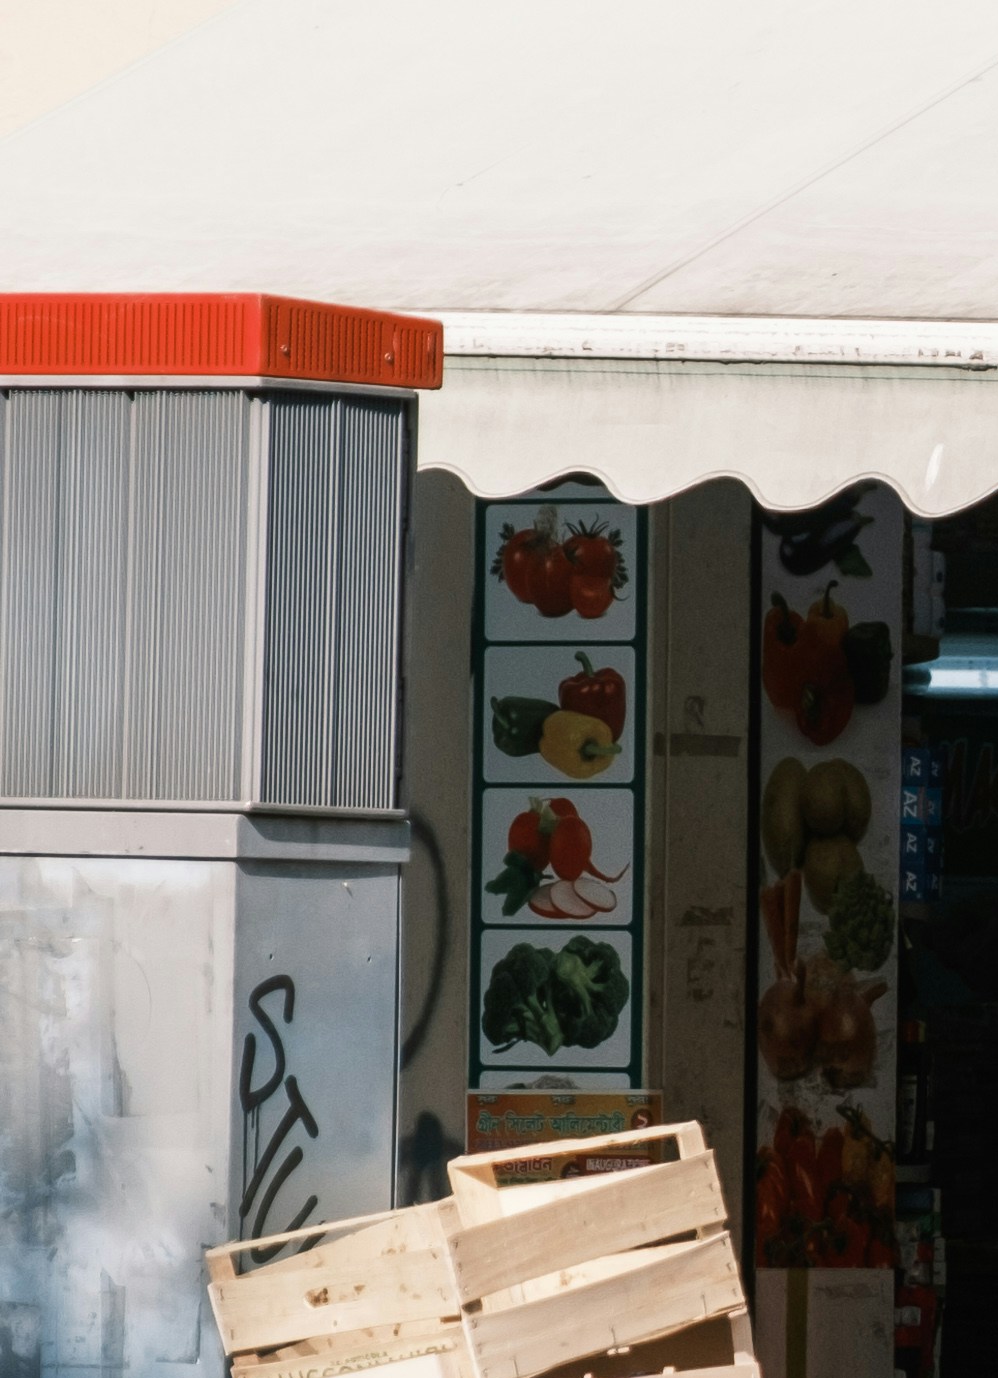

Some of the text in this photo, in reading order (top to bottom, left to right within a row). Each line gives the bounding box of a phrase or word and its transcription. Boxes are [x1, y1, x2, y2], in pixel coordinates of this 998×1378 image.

[910, 756, 921, 776] AZ
[903, 791, 917, 818] AZ
[906, 833, 917, 853] AZ
[906, 871, 917, 892] AZ
